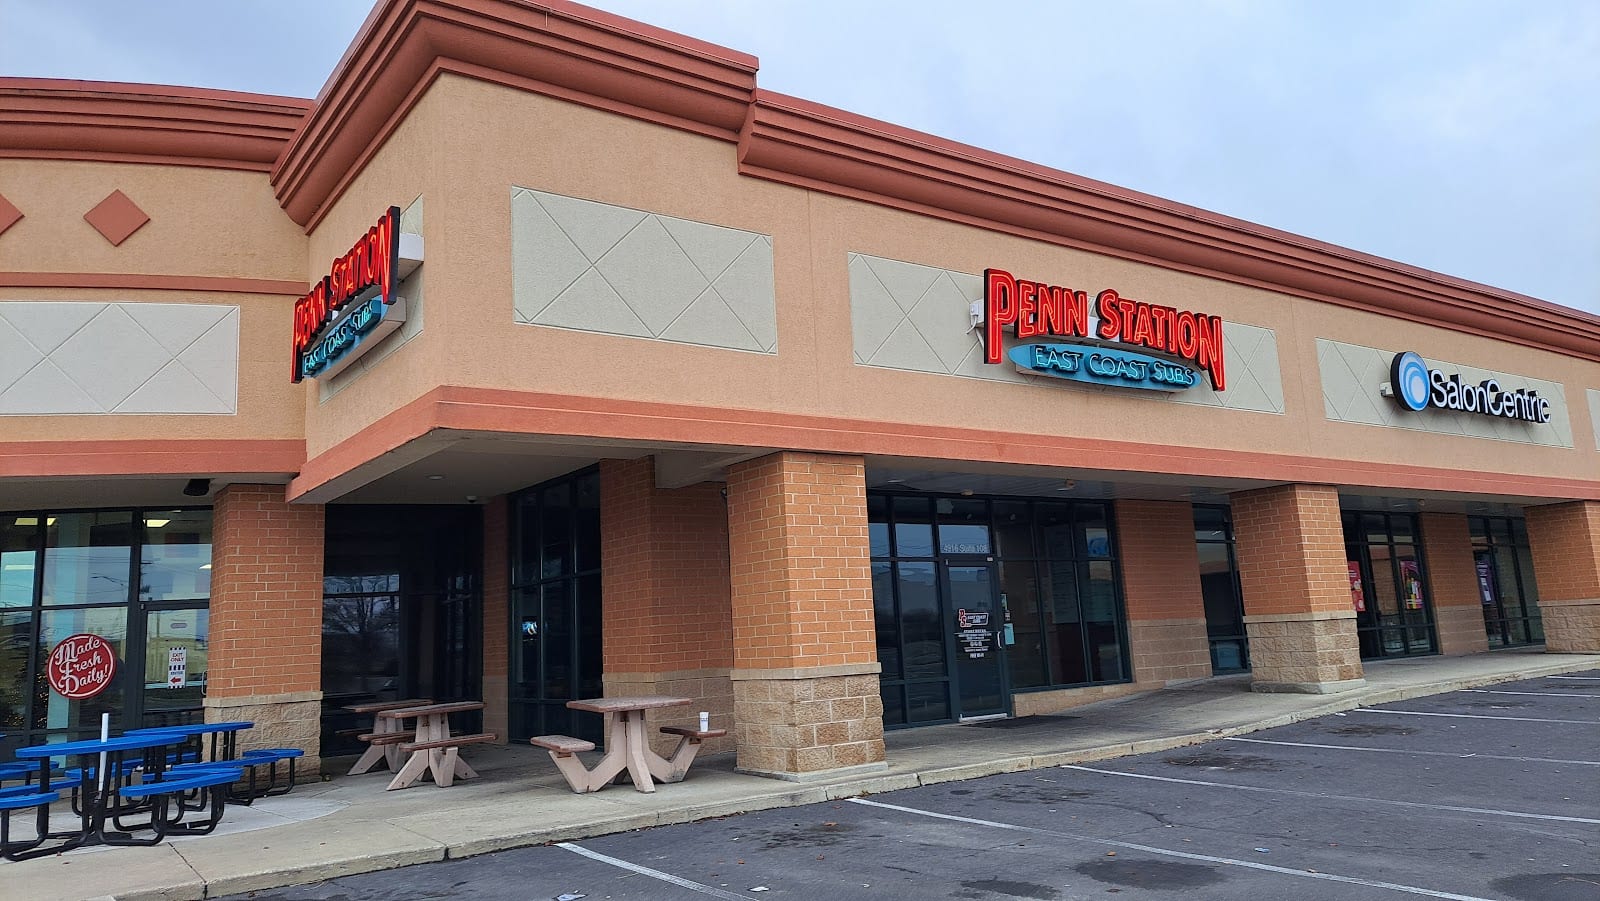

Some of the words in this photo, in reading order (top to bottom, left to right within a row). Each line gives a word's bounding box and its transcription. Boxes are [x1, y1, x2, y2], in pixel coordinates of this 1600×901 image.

[291, 276, 331, 384] PENN
[330, 206, 400, 310] STATION
[303, 347, 324, 374] EAST
[322, 325, 352, 359] COAST
[984, 268, 1088, 364] PENN
[1096, 288, 1226, 392] STATION
[1033, 345, 1081, 371] EAST
[1086, 353, 1147, 380] COAST
[1152, 361, 1195, 386] SUBS
[1430, 369, 1551, 423] SalonCentric
[54, 636, 102, 666] Made
[59, 652, 103, 681] Fresh
[58, 664, 109, 695] Daily!
